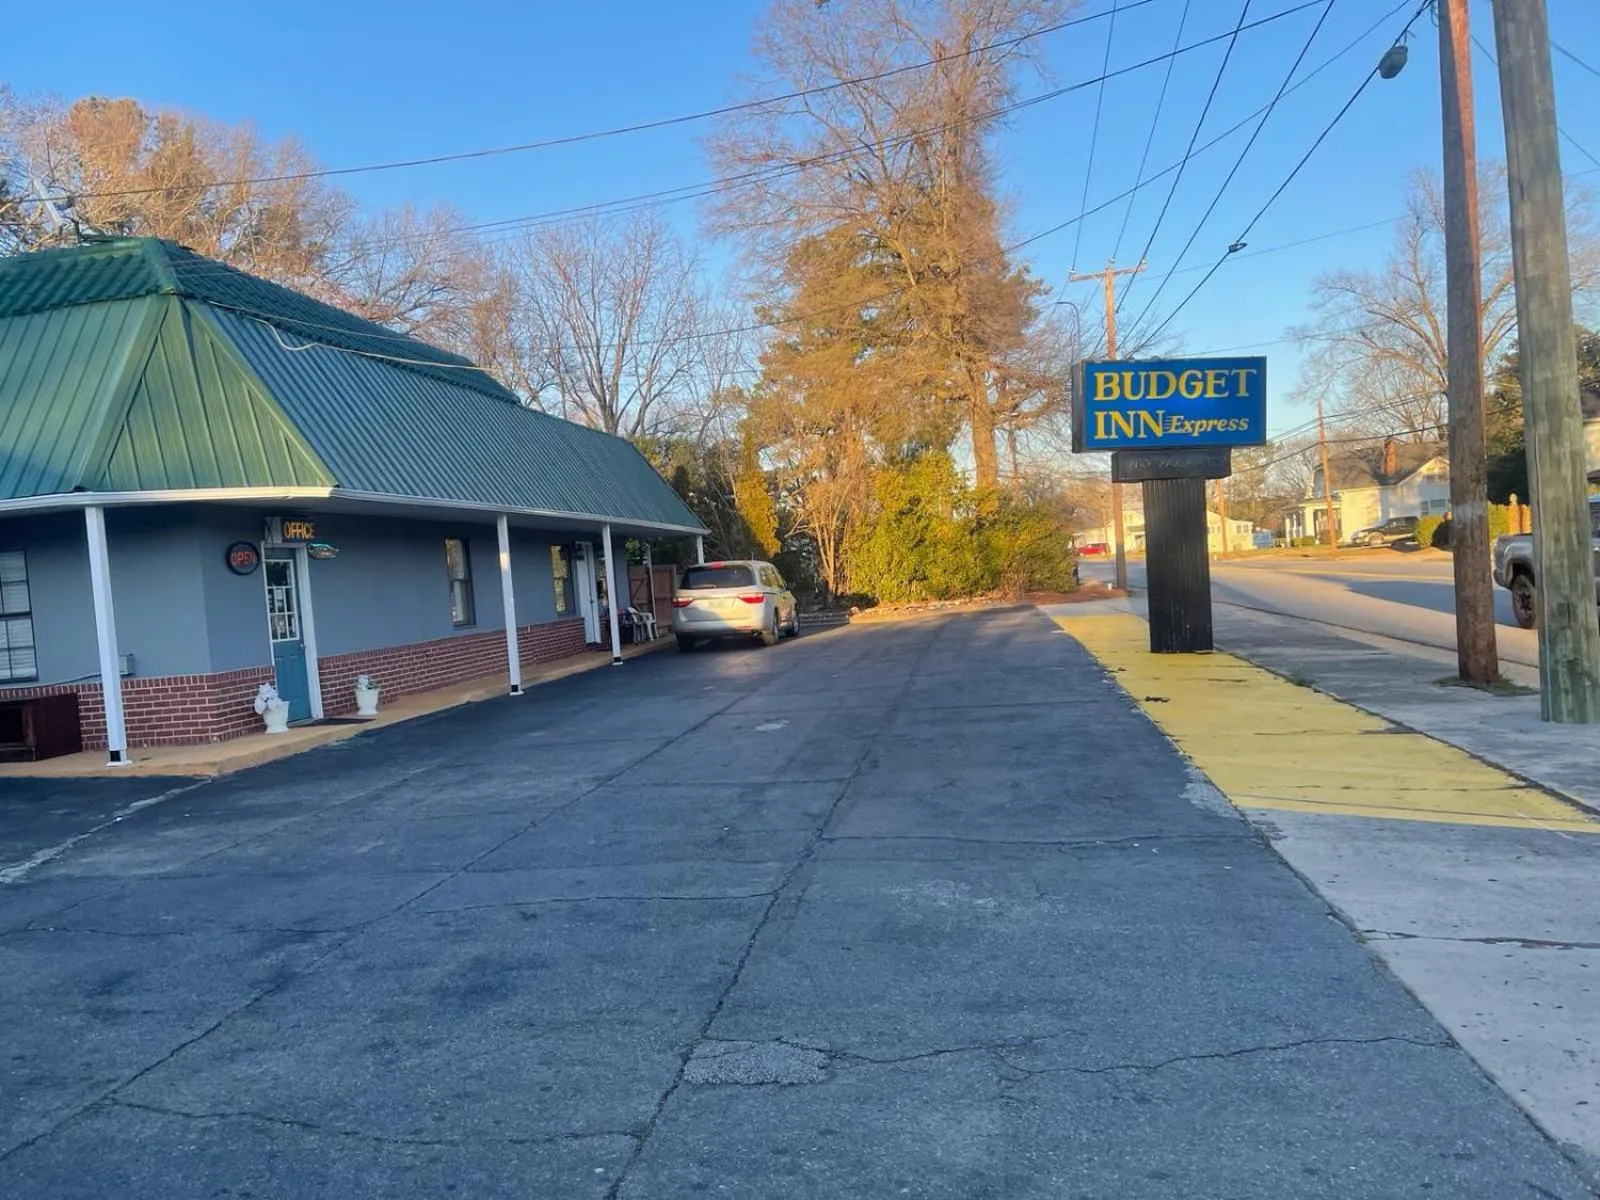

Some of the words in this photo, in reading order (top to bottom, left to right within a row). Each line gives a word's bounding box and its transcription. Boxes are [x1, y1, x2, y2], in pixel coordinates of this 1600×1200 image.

[1093, 368, 1257, 401] BUDGET
[1093, 409, 1165, 440] INN
[1168, 415, 1250, 437] Express
[283, 521, 316, 539] OFFICE
[230, 550, 257, 567] OPEN
